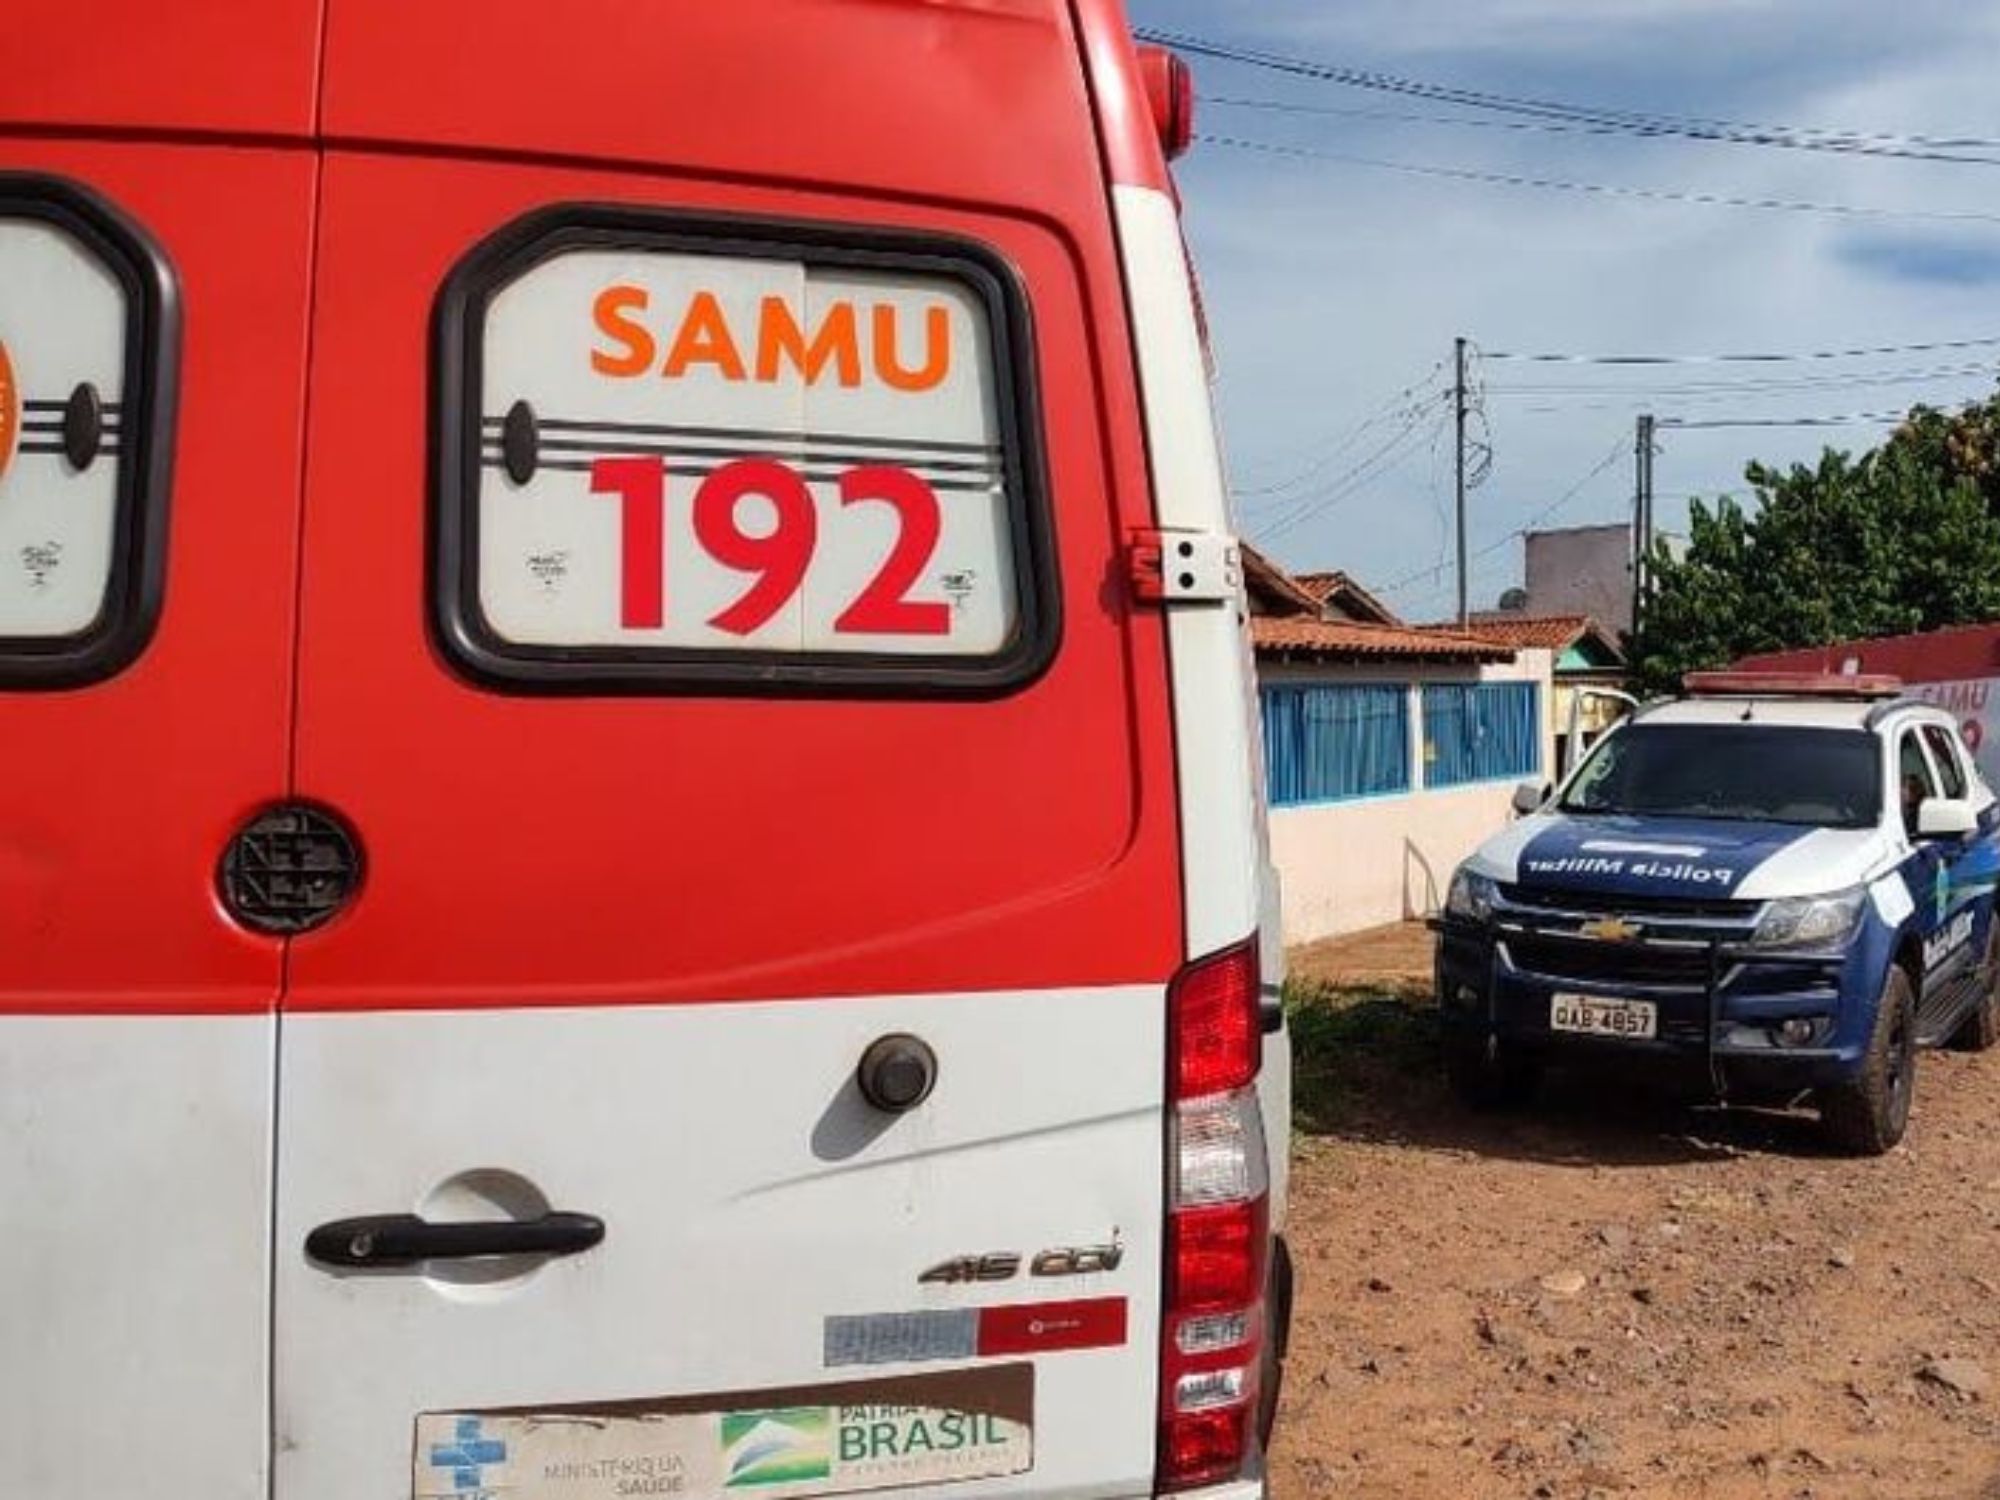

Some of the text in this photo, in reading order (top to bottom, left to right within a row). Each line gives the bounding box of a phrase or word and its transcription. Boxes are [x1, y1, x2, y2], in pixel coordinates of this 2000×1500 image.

[589, 285, 950, 392] SAMU
[589, 454, 950, 635] 192
[839, 1413, 1007, 1462] BRASIL
